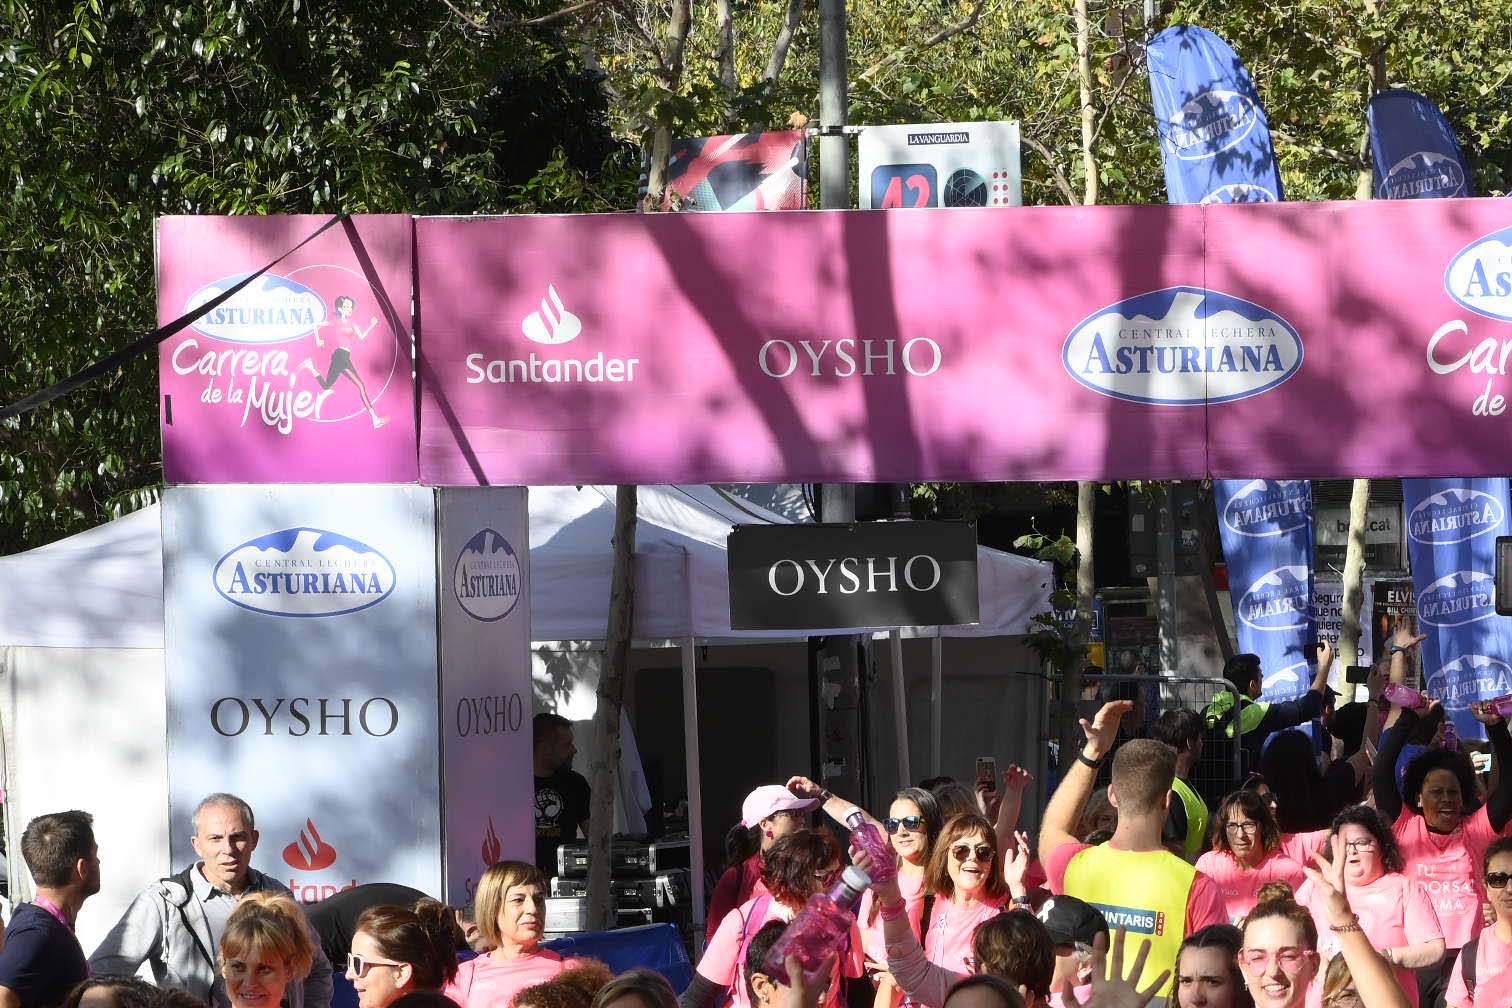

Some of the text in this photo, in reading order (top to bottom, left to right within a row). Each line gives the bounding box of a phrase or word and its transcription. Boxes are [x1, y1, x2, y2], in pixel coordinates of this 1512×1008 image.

[171, 338, 289, 376] Carrera
[465, 350, 640, 385] Santander
[758, 336, 943, 378] OYSHO
[1081, 331, 1286, 377] ASTURIANA
[200, 373, 335, 435] de la Mujer
[1471, 377, 1507, 417] de
[227, 560, 383, 595] ASTURIANA
[255, 558, 313, 568] CENTRAL
[768, 554, 941, 596] OYSHO
[459, 567, 518, 600] ASTURIANA
[210, 696, 400, 738] OYSHO
[456, 693, 523, 738] OYSHO
[1416, 863, 1435, 877] TU
